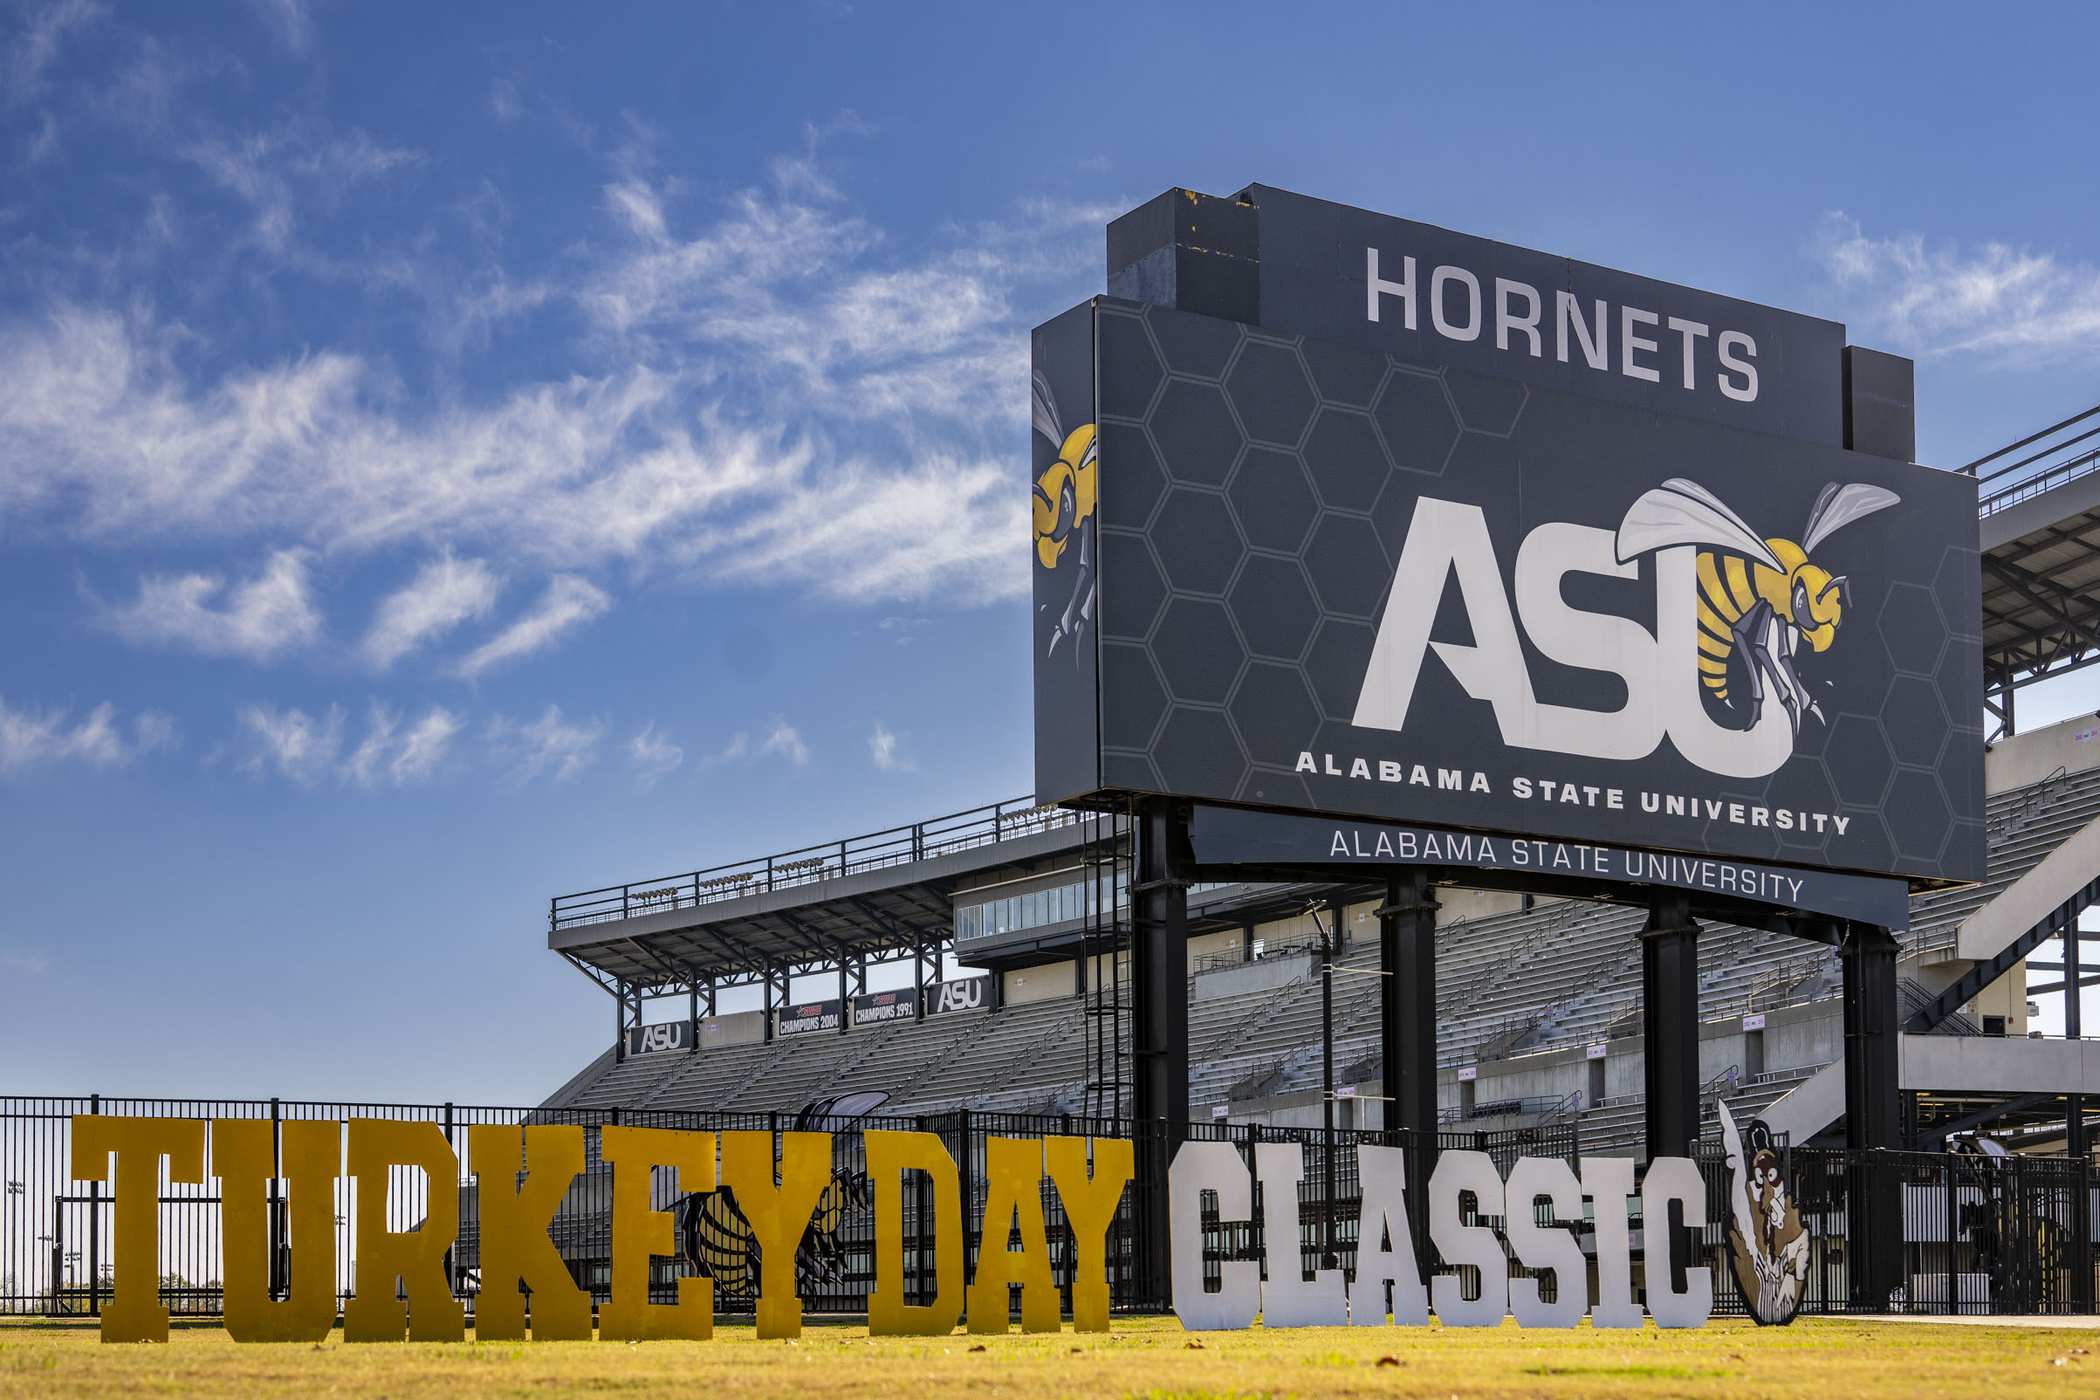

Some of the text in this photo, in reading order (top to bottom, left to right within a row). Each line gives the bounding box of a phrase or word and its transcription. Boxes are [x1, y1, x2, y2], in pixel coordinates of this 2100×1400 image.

[1367, 247, 1759, 402] HORNETS
[1351, 495, 1794, 778] ASU
[1295, 752, 1850, 835] ALABAMA STATE UNIVERSITY
[1330, 830, 1804, 903] ALABAMA STATE UNIVERSITY
[780, 1013, 839, 1035] CHAMPIONS 2004
[855, 1002, 914, 1024] CHAMPIONS 1991
[937, 979, 982, 1013] ASU
[640, 1023, 682, 1053] ASU
[71, 1114, 1714, 1343] TURKEY DAY CLASSIC
